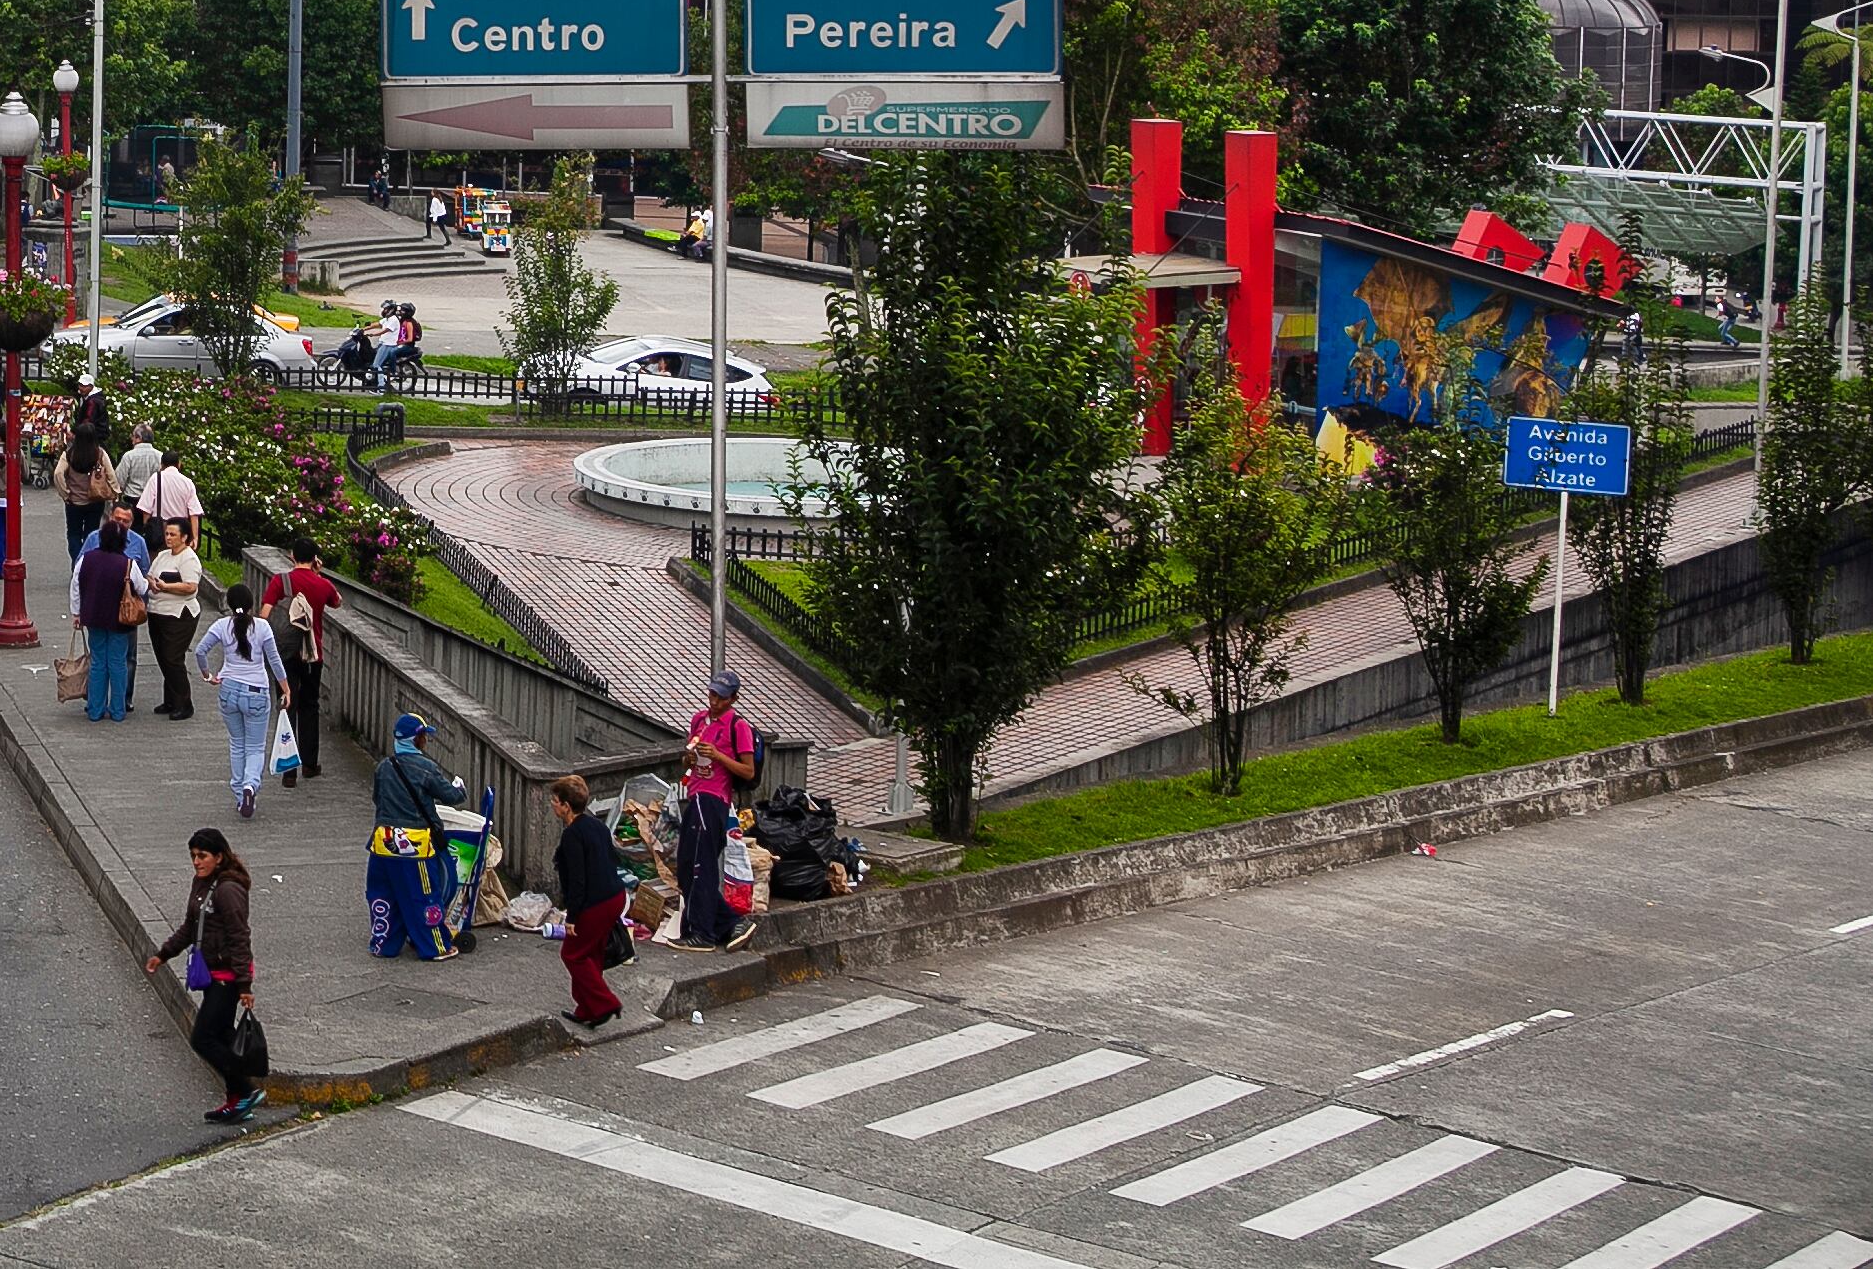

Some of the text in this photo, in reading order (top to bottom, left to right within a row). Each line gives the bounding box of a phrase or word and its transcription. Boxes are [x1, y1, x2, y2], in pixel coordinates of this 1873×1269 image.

[451, 17, 605, 52] Centro
[786, 12, 956, 48] Pereira
[886, 105, 1011, 114] SUPERMERCADO
[817, 113, 1023, 136] DELCENTRO
[841, 138, 894, 149] Centro
[897, 139, 917, 149] de
[920, 141, 937, 149] su
